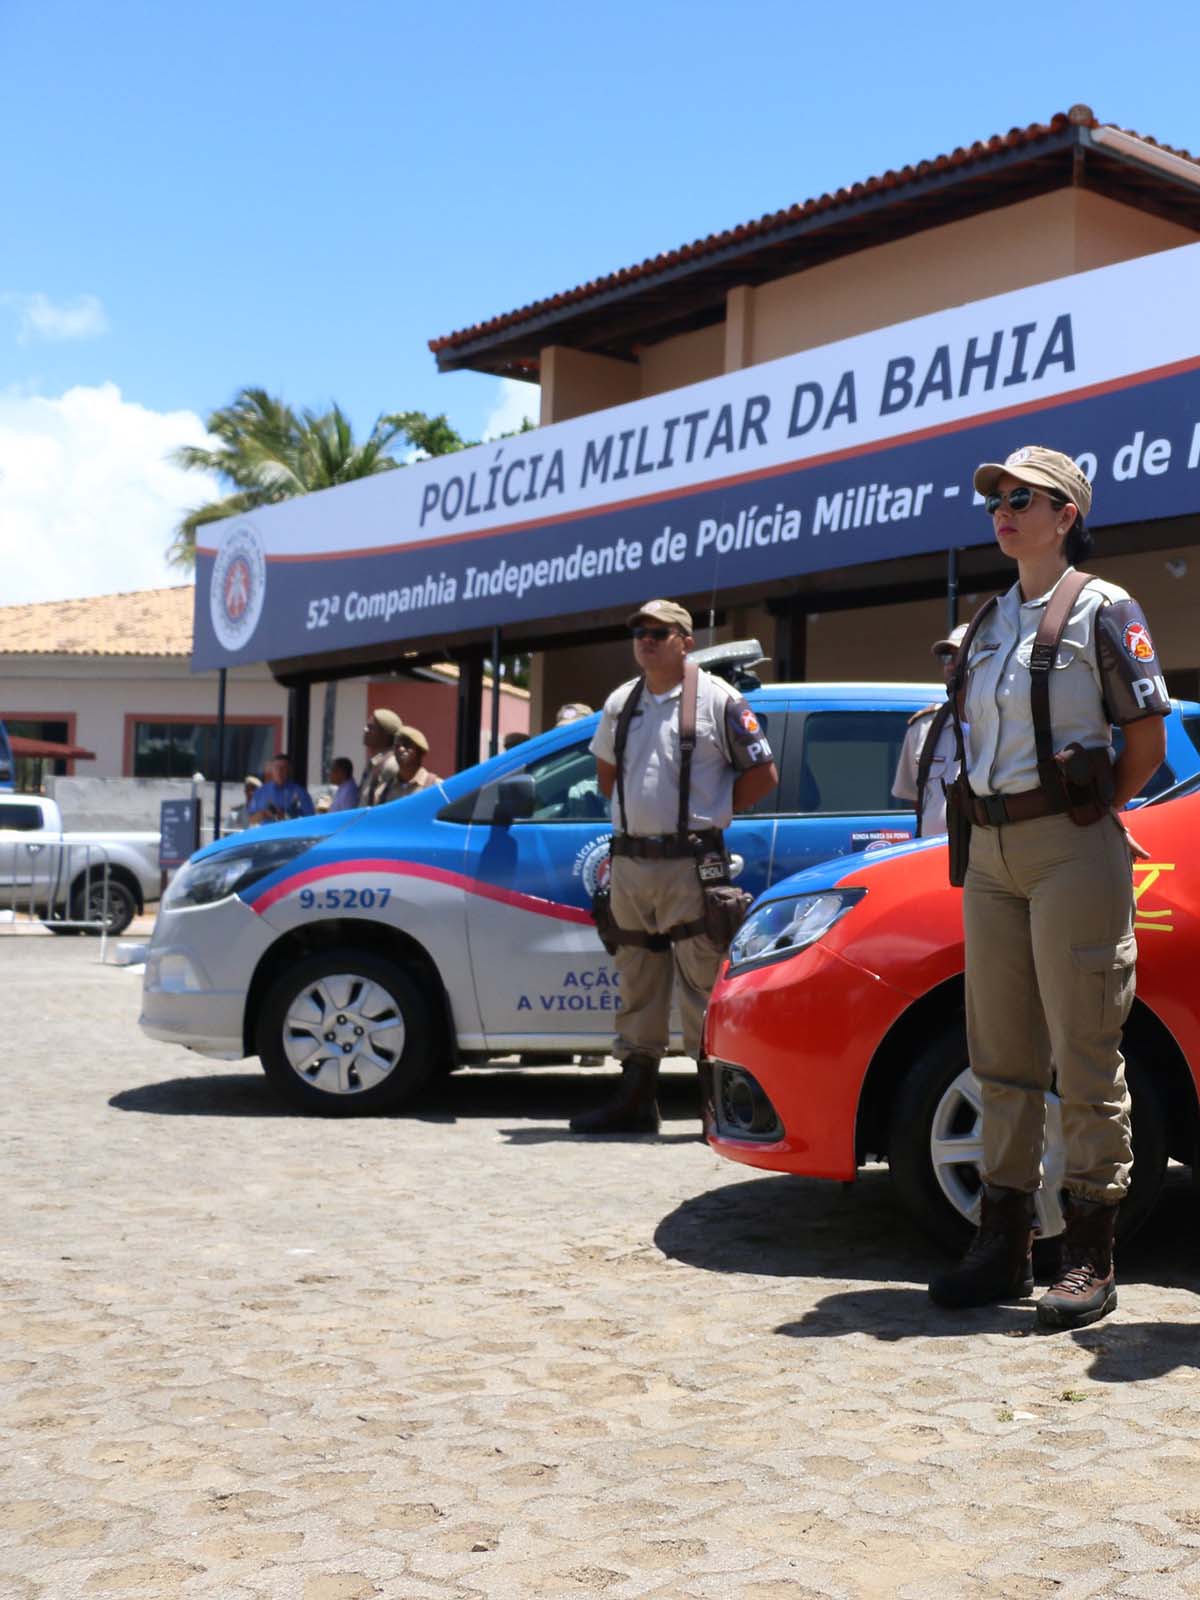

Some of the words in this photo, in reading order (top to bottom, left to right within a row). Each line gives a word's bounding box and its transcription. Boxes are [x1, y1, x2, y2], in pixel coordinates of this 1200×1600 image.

[419, 448, 565, 528] POLÍCIA
[579, 394, 771, 489] MILITAR
[787, 369, 858, 439] DA
[879, 312, 1076, 417] BAHIA
[305, 594, 341, 631] 52ª
[343, 571, 458, 623] Companhia
[462, 537, 643, 599] Independente
[650, 525, 688, 567] de
[695, 502, 802, 558] Polícia
[812, 482, 933, 537] Militar
[1111, 430, 1170, 482] de
[572, 840, 597, 876] POLÍCIA
[299, 887, 393, 910] 9.5207
[516, 994, 533, 1011] A
